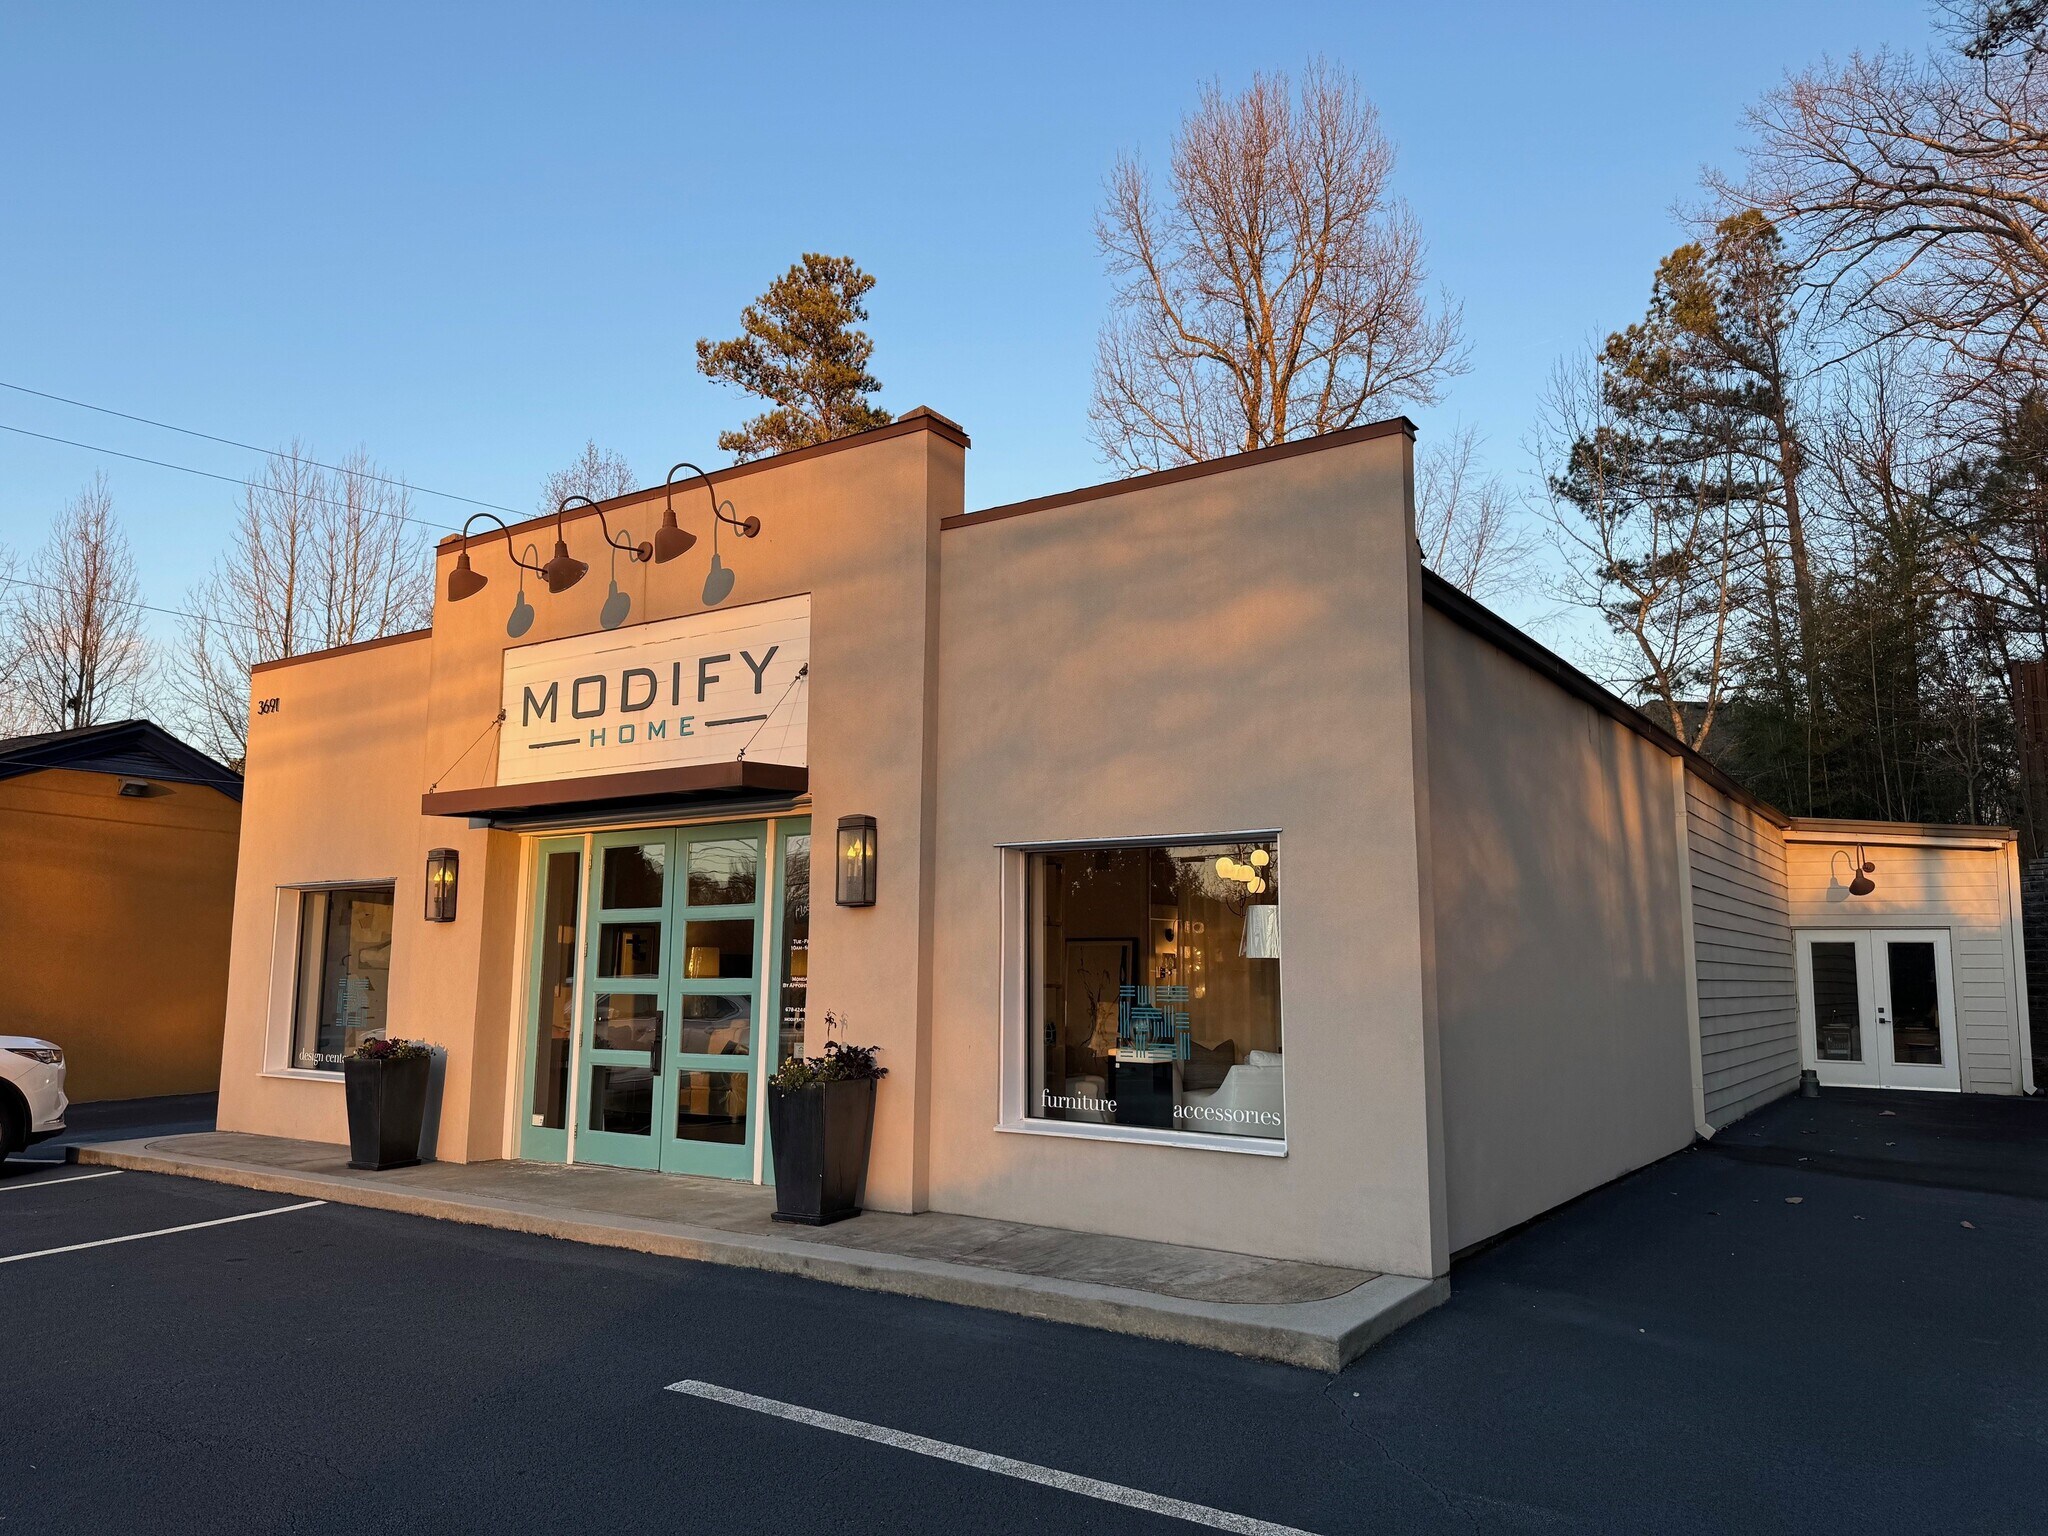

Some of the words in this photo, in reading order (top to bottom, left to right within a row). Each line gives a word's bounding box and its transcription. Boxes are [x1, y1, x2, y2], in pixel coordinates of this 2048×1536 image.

[523, 645, 779, 727] MODIFY
[590, 715, 695, 748] HOME
[299, 1047, 324, 1066] design
[1041, 1088, 1118, 1113] furniture
[1173, 1104, 1281, 1126] accessories
